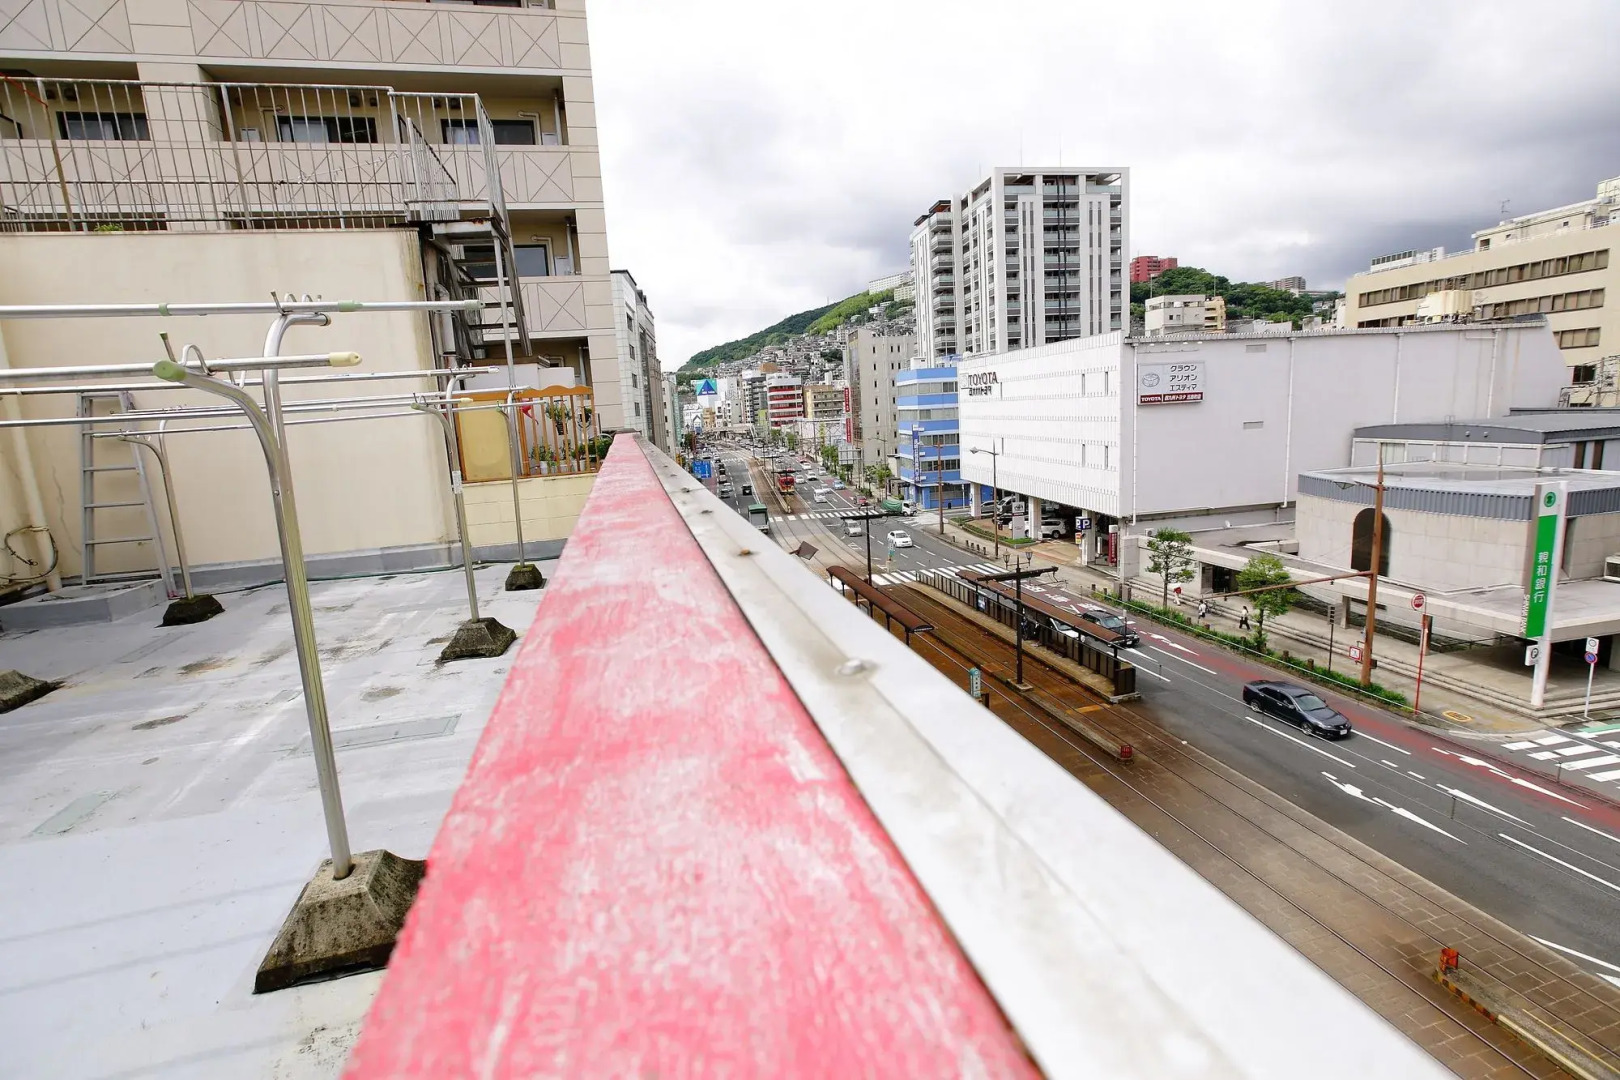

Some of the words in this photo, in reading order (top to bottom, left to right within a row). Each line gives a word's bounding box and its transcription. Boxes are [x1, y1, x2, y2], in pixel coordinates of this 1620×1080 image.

[968, 372, 999, 386] TOYOTA
[1170, 374, 1197, 382] アリオン
[1082, 519, 1090, 529] P
